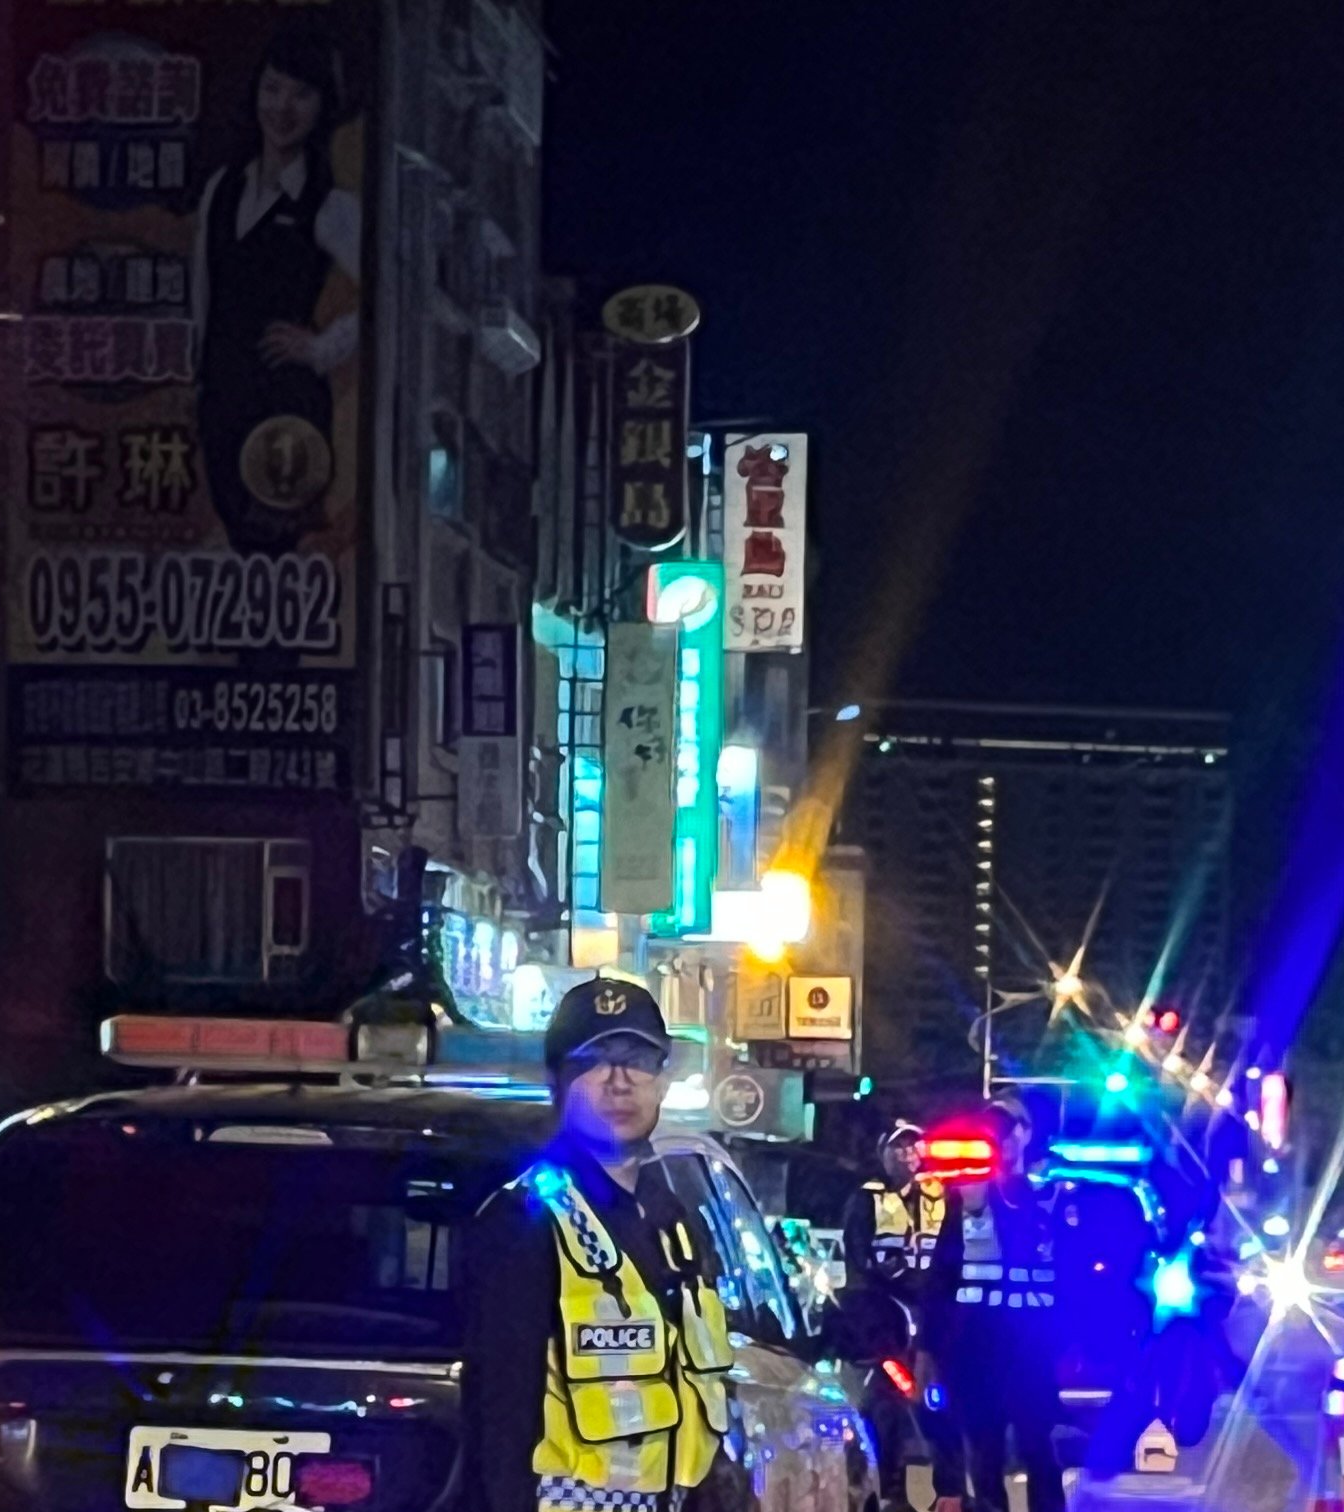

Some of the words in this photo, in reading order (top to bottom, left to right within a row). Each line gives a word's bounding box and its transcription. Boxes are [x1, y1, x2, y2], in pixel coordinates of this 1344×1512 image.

[28, 551, 338, 650] 0955-072962
[173, 681, 338, 733] 03-8525258
[579, 1326, 652, 1349] POLICE
